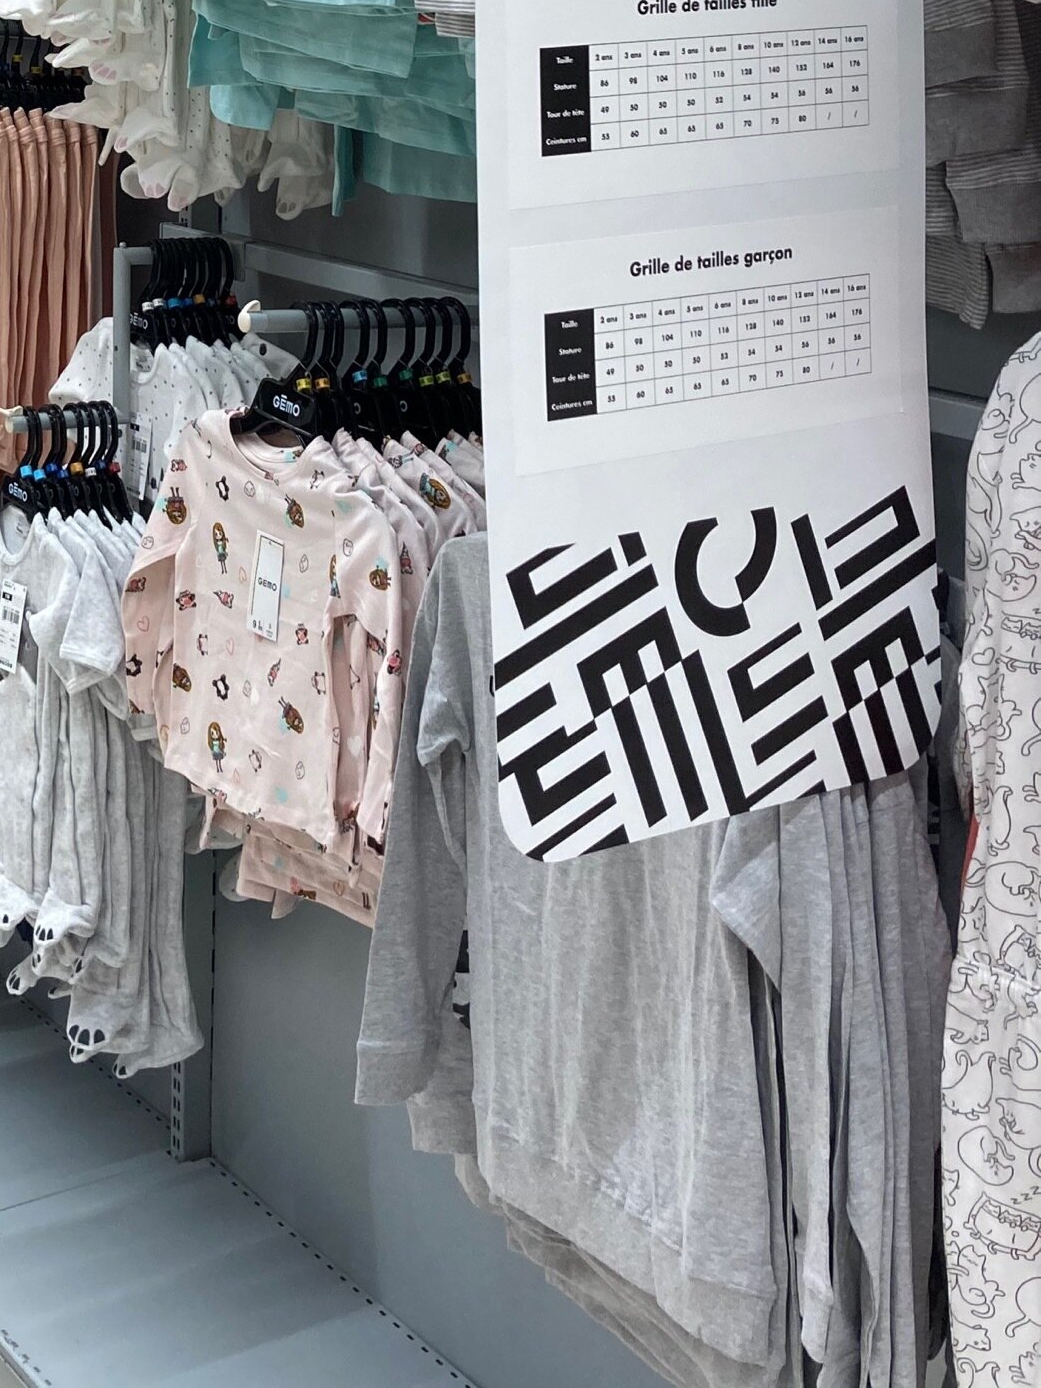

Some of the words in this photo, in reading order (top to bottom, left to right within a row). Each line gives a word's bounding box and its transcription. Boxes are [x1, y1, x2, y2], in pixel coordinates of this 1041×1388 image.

[630, 258, 670, 277] Grille
[675, 255, 692, 272] de
[697, 250, 739, 269] tailles
[744, 248, 792, 268] garçon
